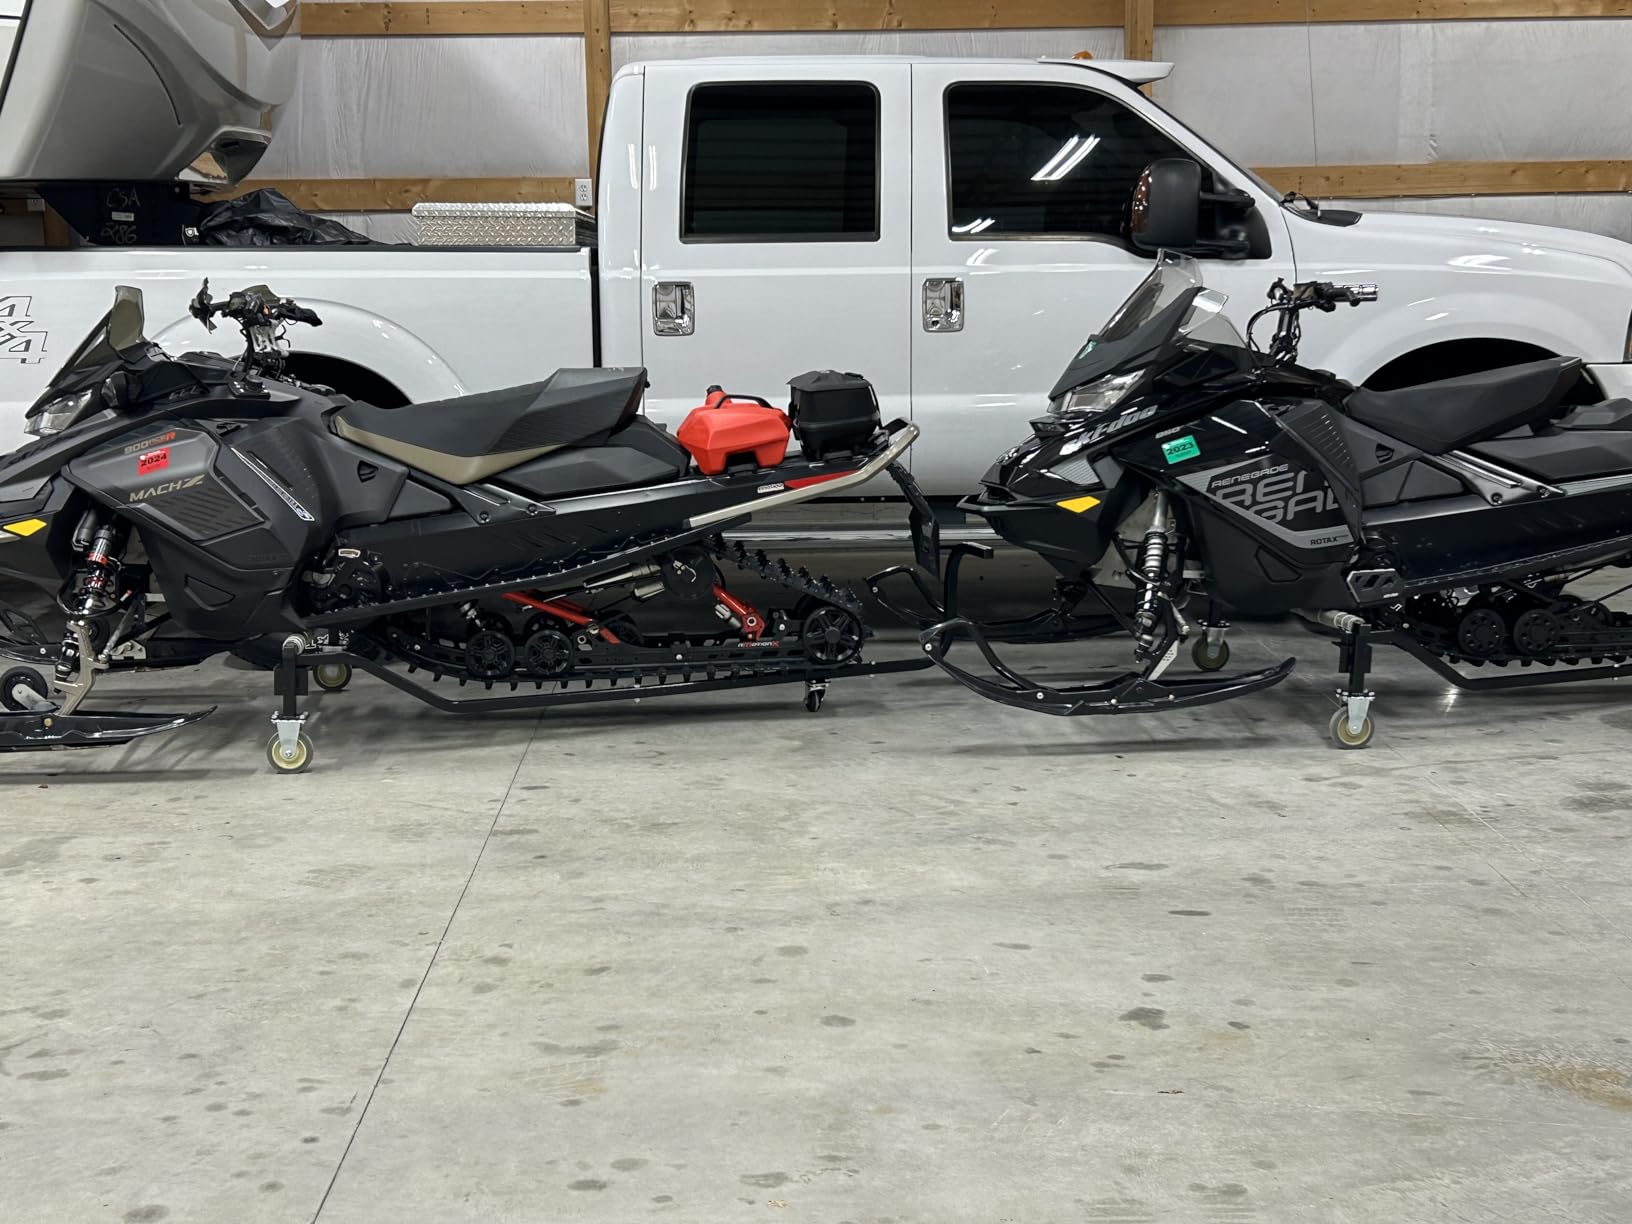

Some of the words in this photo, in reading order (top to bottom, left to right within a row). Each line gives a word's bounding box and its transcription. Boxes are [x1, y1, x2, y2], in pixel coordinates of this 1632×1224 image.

[1167, 442, 1194, 456] 2023
[140, 453, 167, 467] 2024
[1211, 463, 1288, 488] RENEGADE
[1310, 536, 1338, 545] ROTAX
